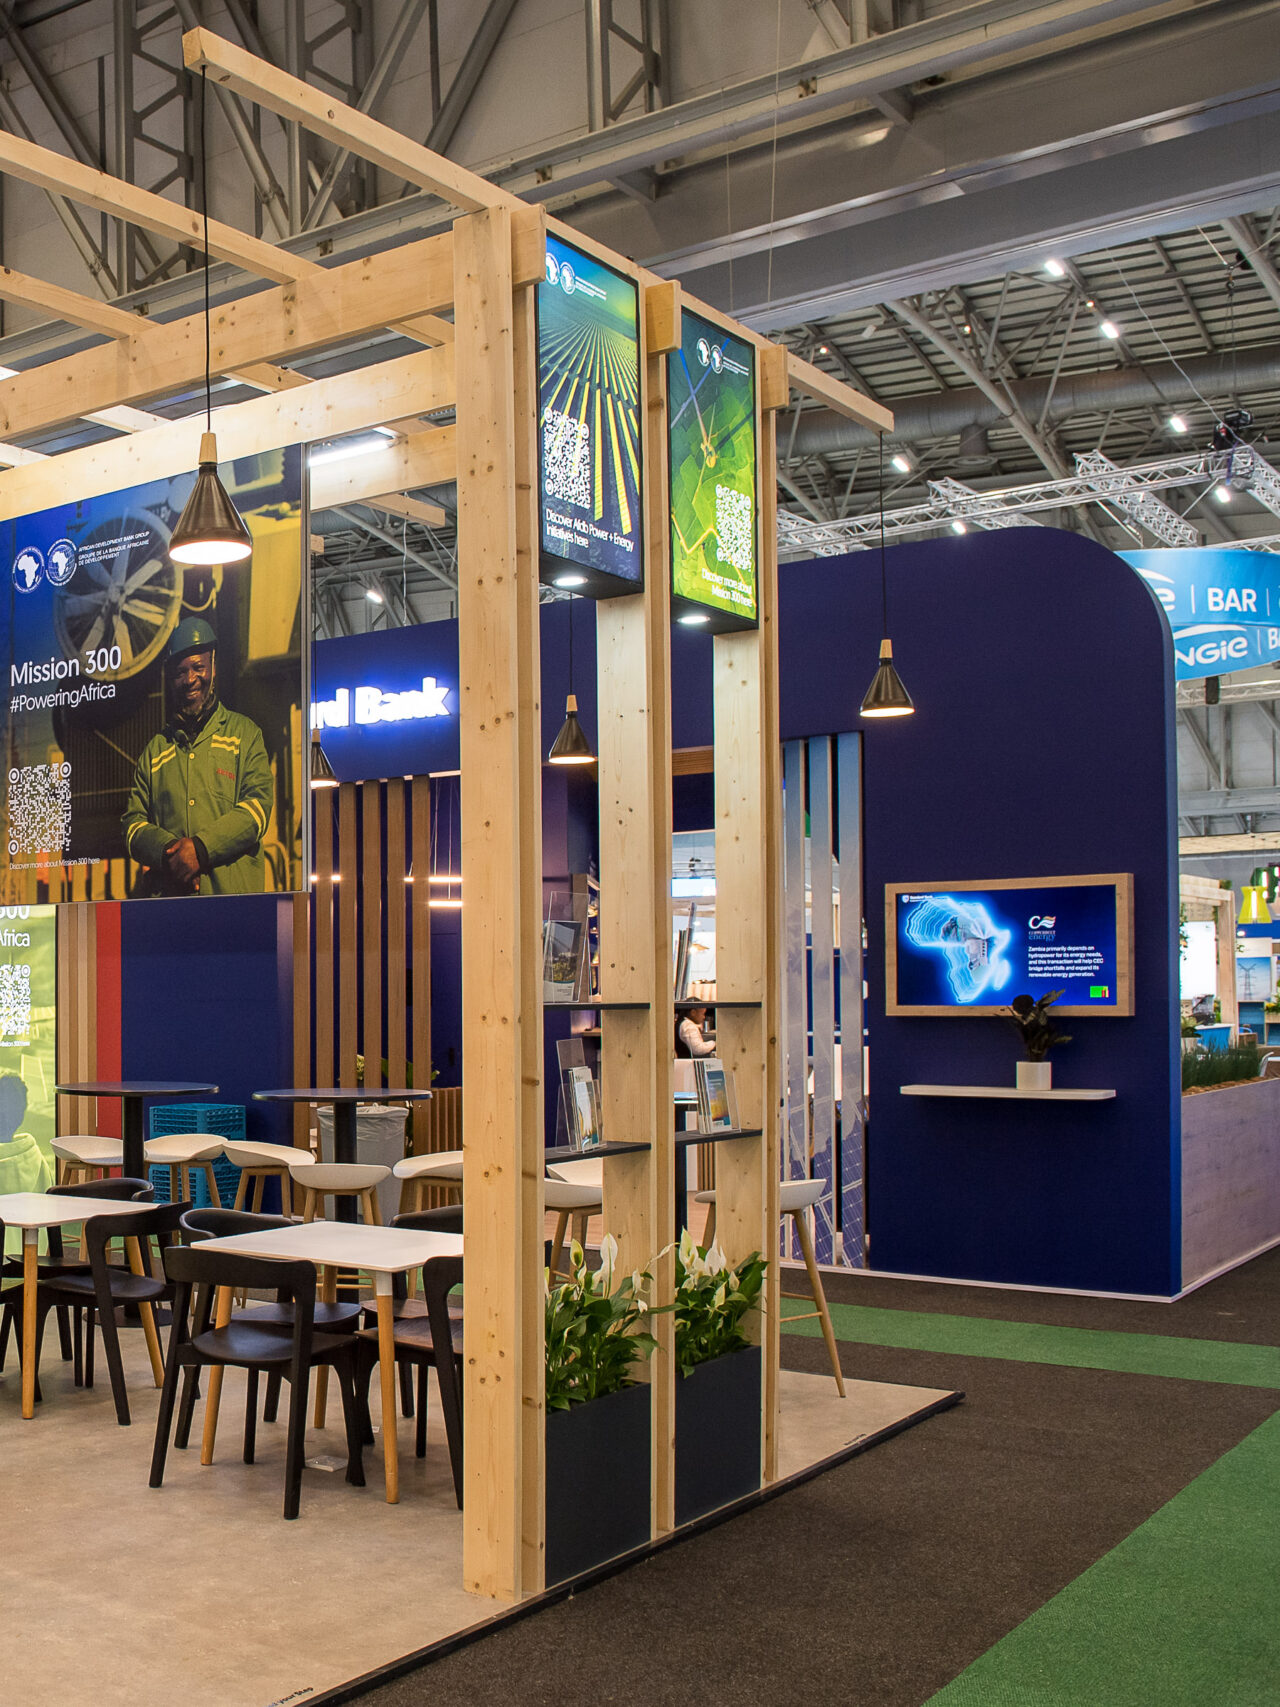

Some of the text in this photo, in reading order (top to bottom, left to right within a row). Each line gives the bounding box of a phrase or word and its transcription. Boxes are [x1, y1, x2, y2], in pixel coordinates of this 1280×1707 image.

[78, 531, 150, 552] AFRICAN DEVELOPMENT BANK GROUP
[546, 508, 573, 528] Discover
[589, 523, 608, 541] Power
[614, 532, 634, 552] Energy
[574, 532, 589, 548] here
[78, 552, 96, 560] GROUPE
[109, 545, 127, 554] BANQUE
[127, 539, 149, 550] AFRICAINE
[1207, 587, 1257, 612] BAR
[11, 645, 122, 687] Mission 300
[10, 682, 116, 713] #PoweringAfrica
[354, 676, 451, 725] Bank
[9, 862, 30, 870] Discover
[59, 858, 77, 867] Mission
[78, 857, 87, 865] 300
[88, 857, 101, 865] here
